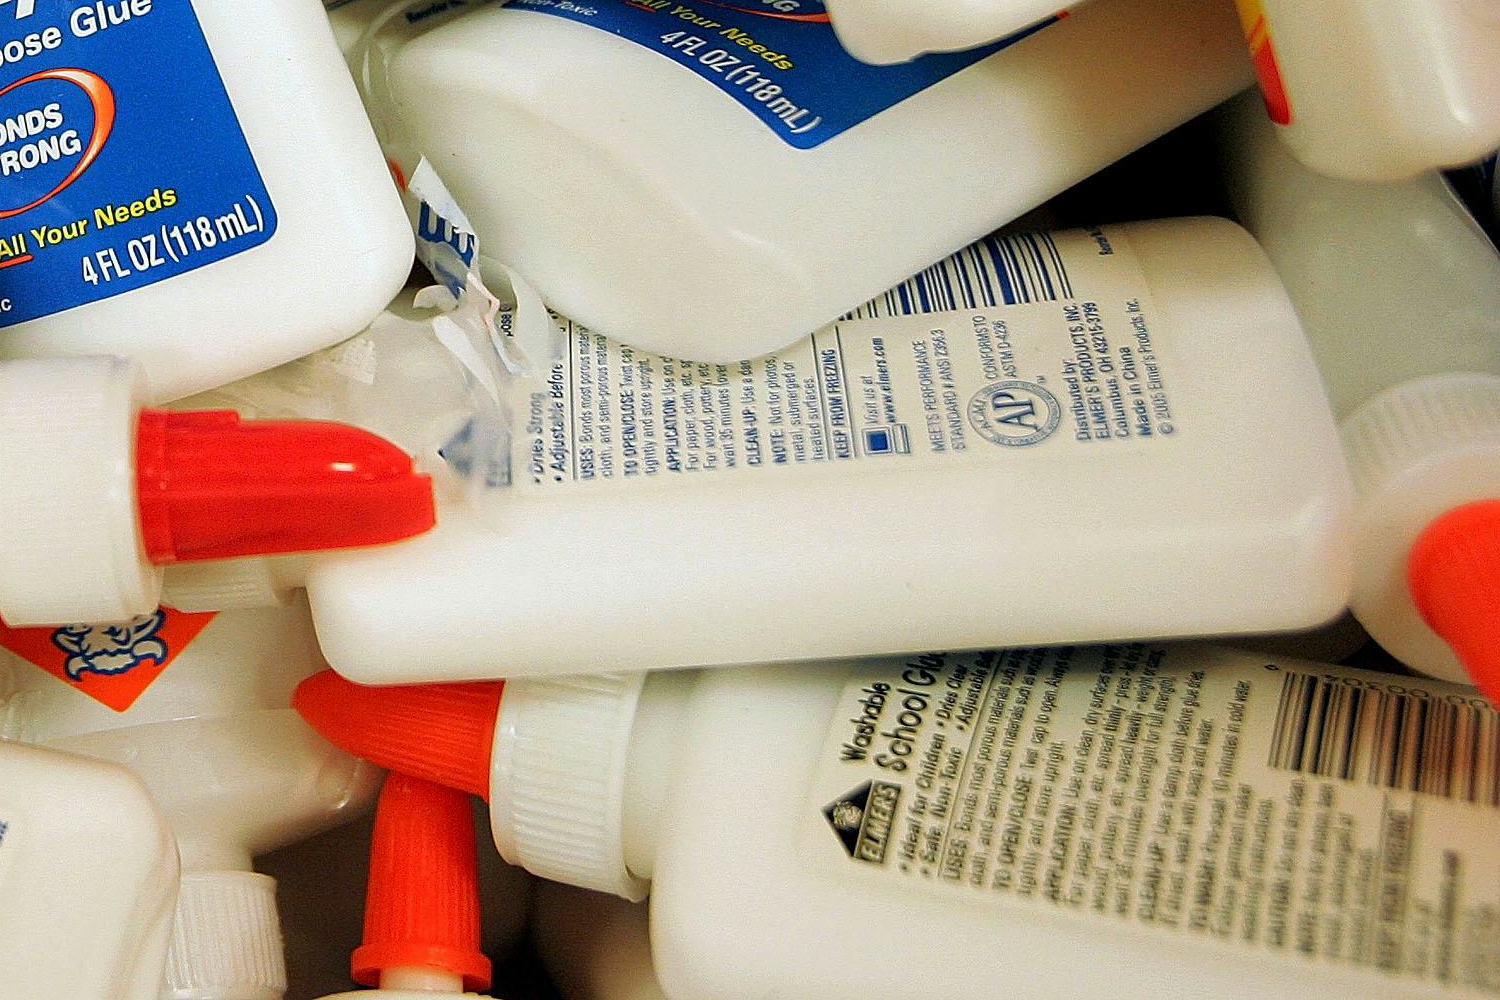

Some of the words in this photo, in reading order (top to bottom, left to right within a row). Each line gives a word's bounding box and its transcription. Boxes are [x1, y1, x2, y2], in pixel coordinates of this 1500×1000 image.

[660, 31, 677, 48] 4
[676, 34, 699, 58] FL
[700, 49, 726, 74] OZ
[670, 2, 720, 30] Your
[720, 27, 795, 72] Needs
[31, 220, 87, 247] Your
[94, 189, 175, 229] Needs
[83, 257, 98, 284] 4
[96, 248, 130, 281] FL
[128, 235, 164, 270] OZ
[1120, 347, 1135, 380] China
[992, 391, 1036, 430] AP
[1126, 381, 1140, 394] in
[1132, 400, 1151, 435] Made
[840, 680, 892, 761] Washable
[875, 689, 930, 772] School
